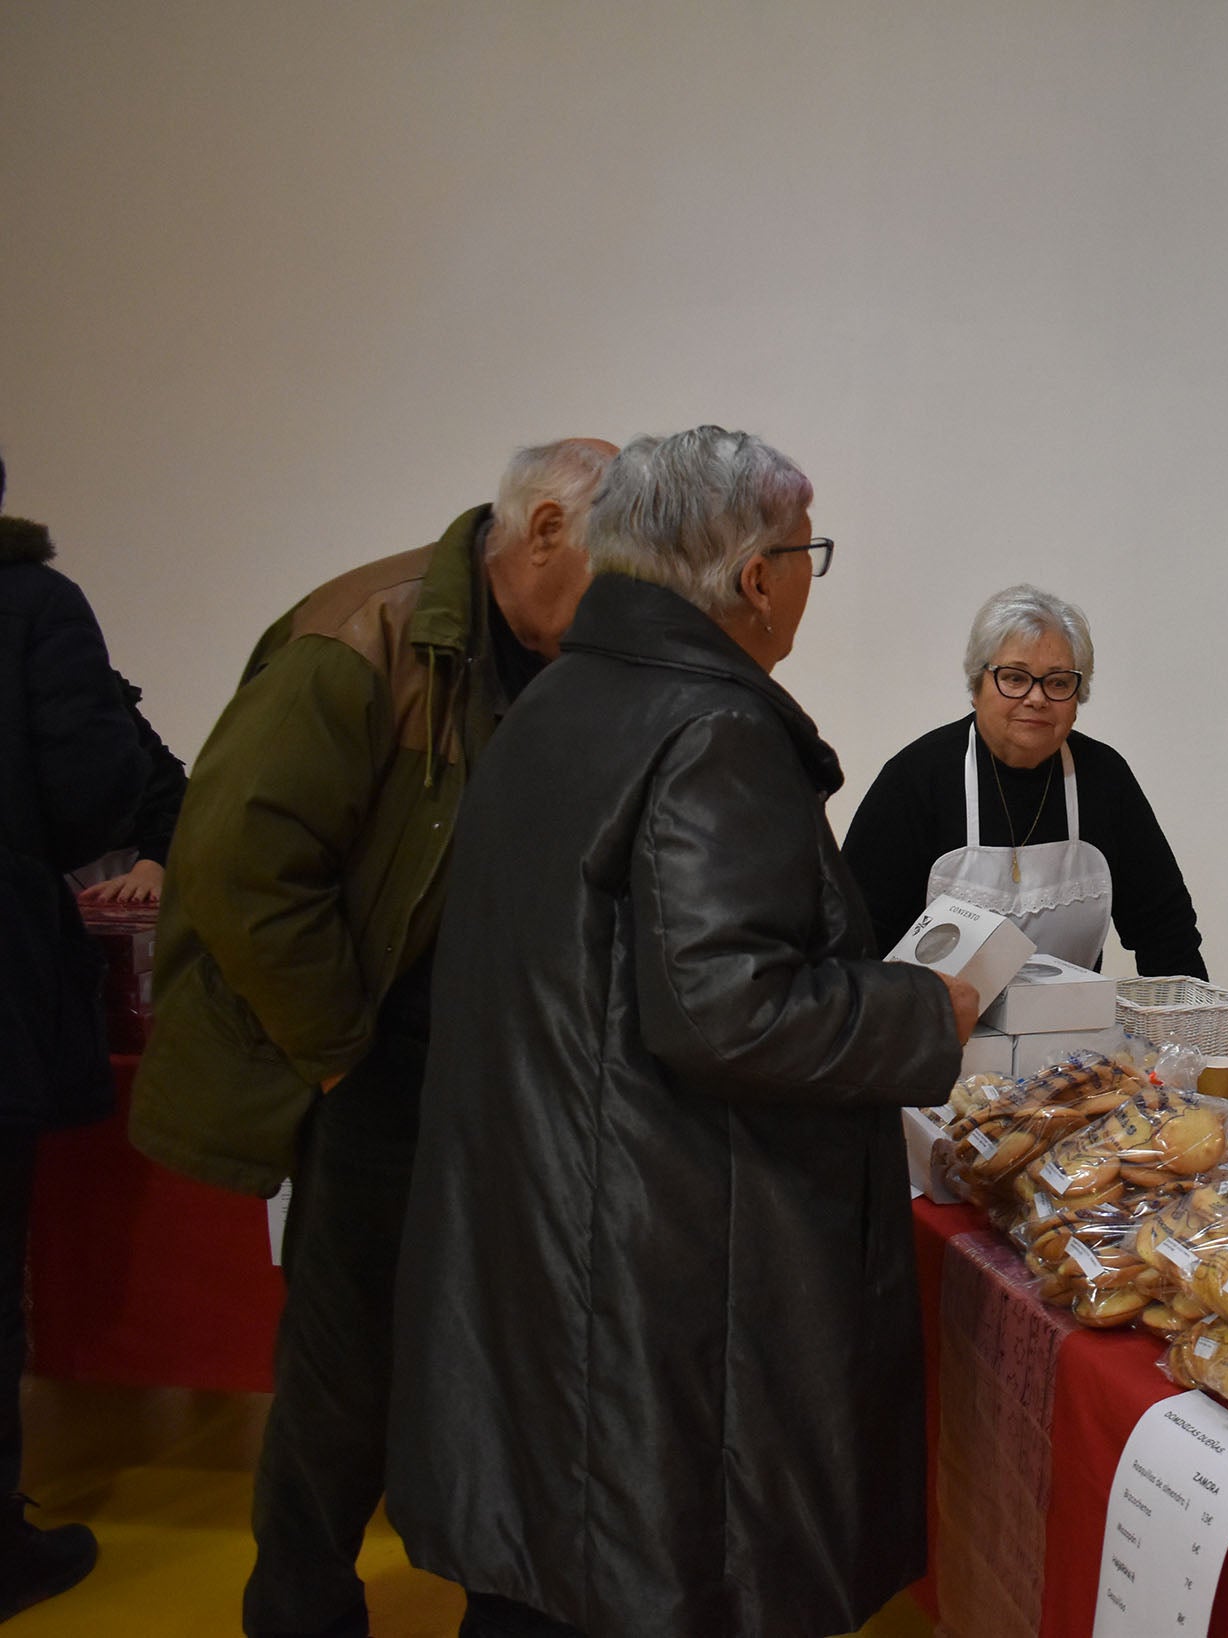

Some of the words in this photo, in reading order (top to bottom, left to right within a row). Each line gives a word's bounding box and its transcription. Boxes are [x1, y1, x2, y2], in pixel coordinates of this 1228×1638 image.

[948, 905, 981, 922] CONVENTO
[1163, 1411, 1202, 1437] DOMINICAS
[1192, 1471, 1220, 1495] ZAMORA
